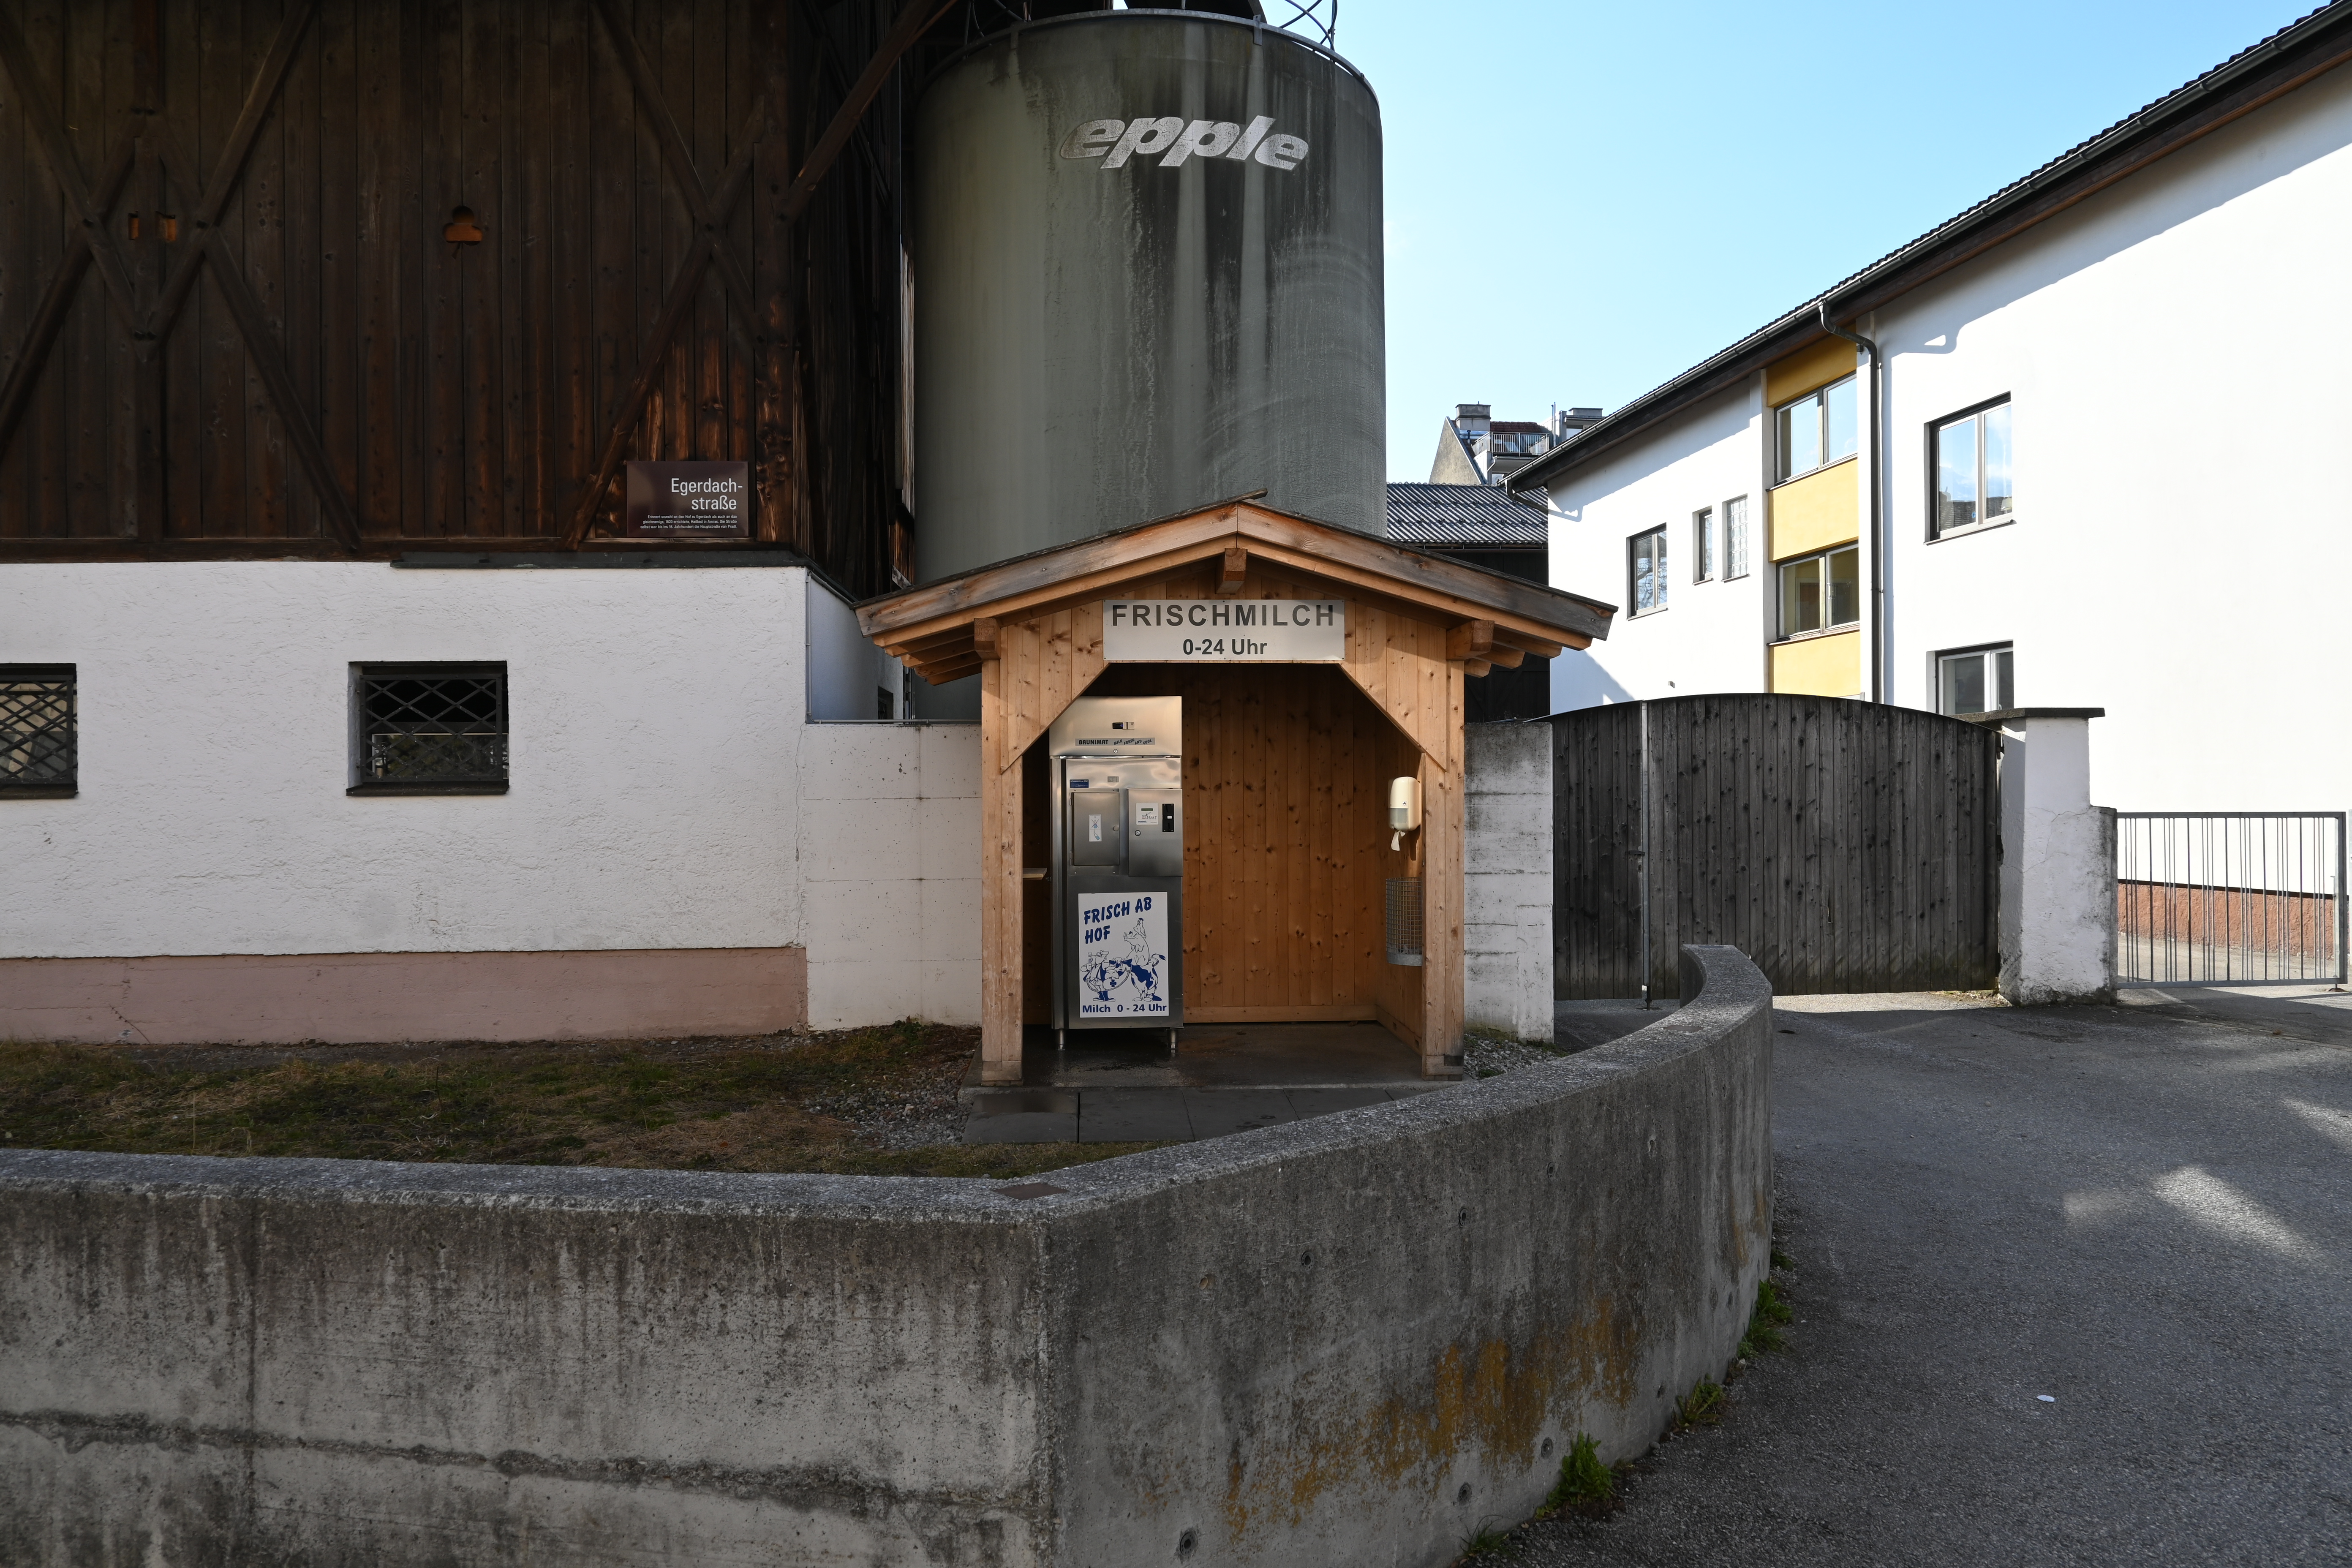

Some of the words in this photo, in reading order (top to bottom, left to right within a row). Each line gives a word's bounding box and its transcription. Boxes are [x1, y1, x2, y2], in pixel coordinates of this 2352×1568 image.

[1060, 115, 1309, 171] epple
[671, 478, 743, 495] Egerdach-
[691, 495, 737, 510] straße
[1112, 604, 1334, 626] FRISCHMILCH
[1183, 639, 1225, 655] 0-24
[1231, 638, 1268, 655] Uhr
[1084, 901, 1130, 925] FRISCH
[1135, 896, 1152, 913] AB
[1085, 925, 1110, 944] HOF
[1082, 1004, 1111, 1013] Milch
[1149, 1003, 1167, 1012] Uhr
